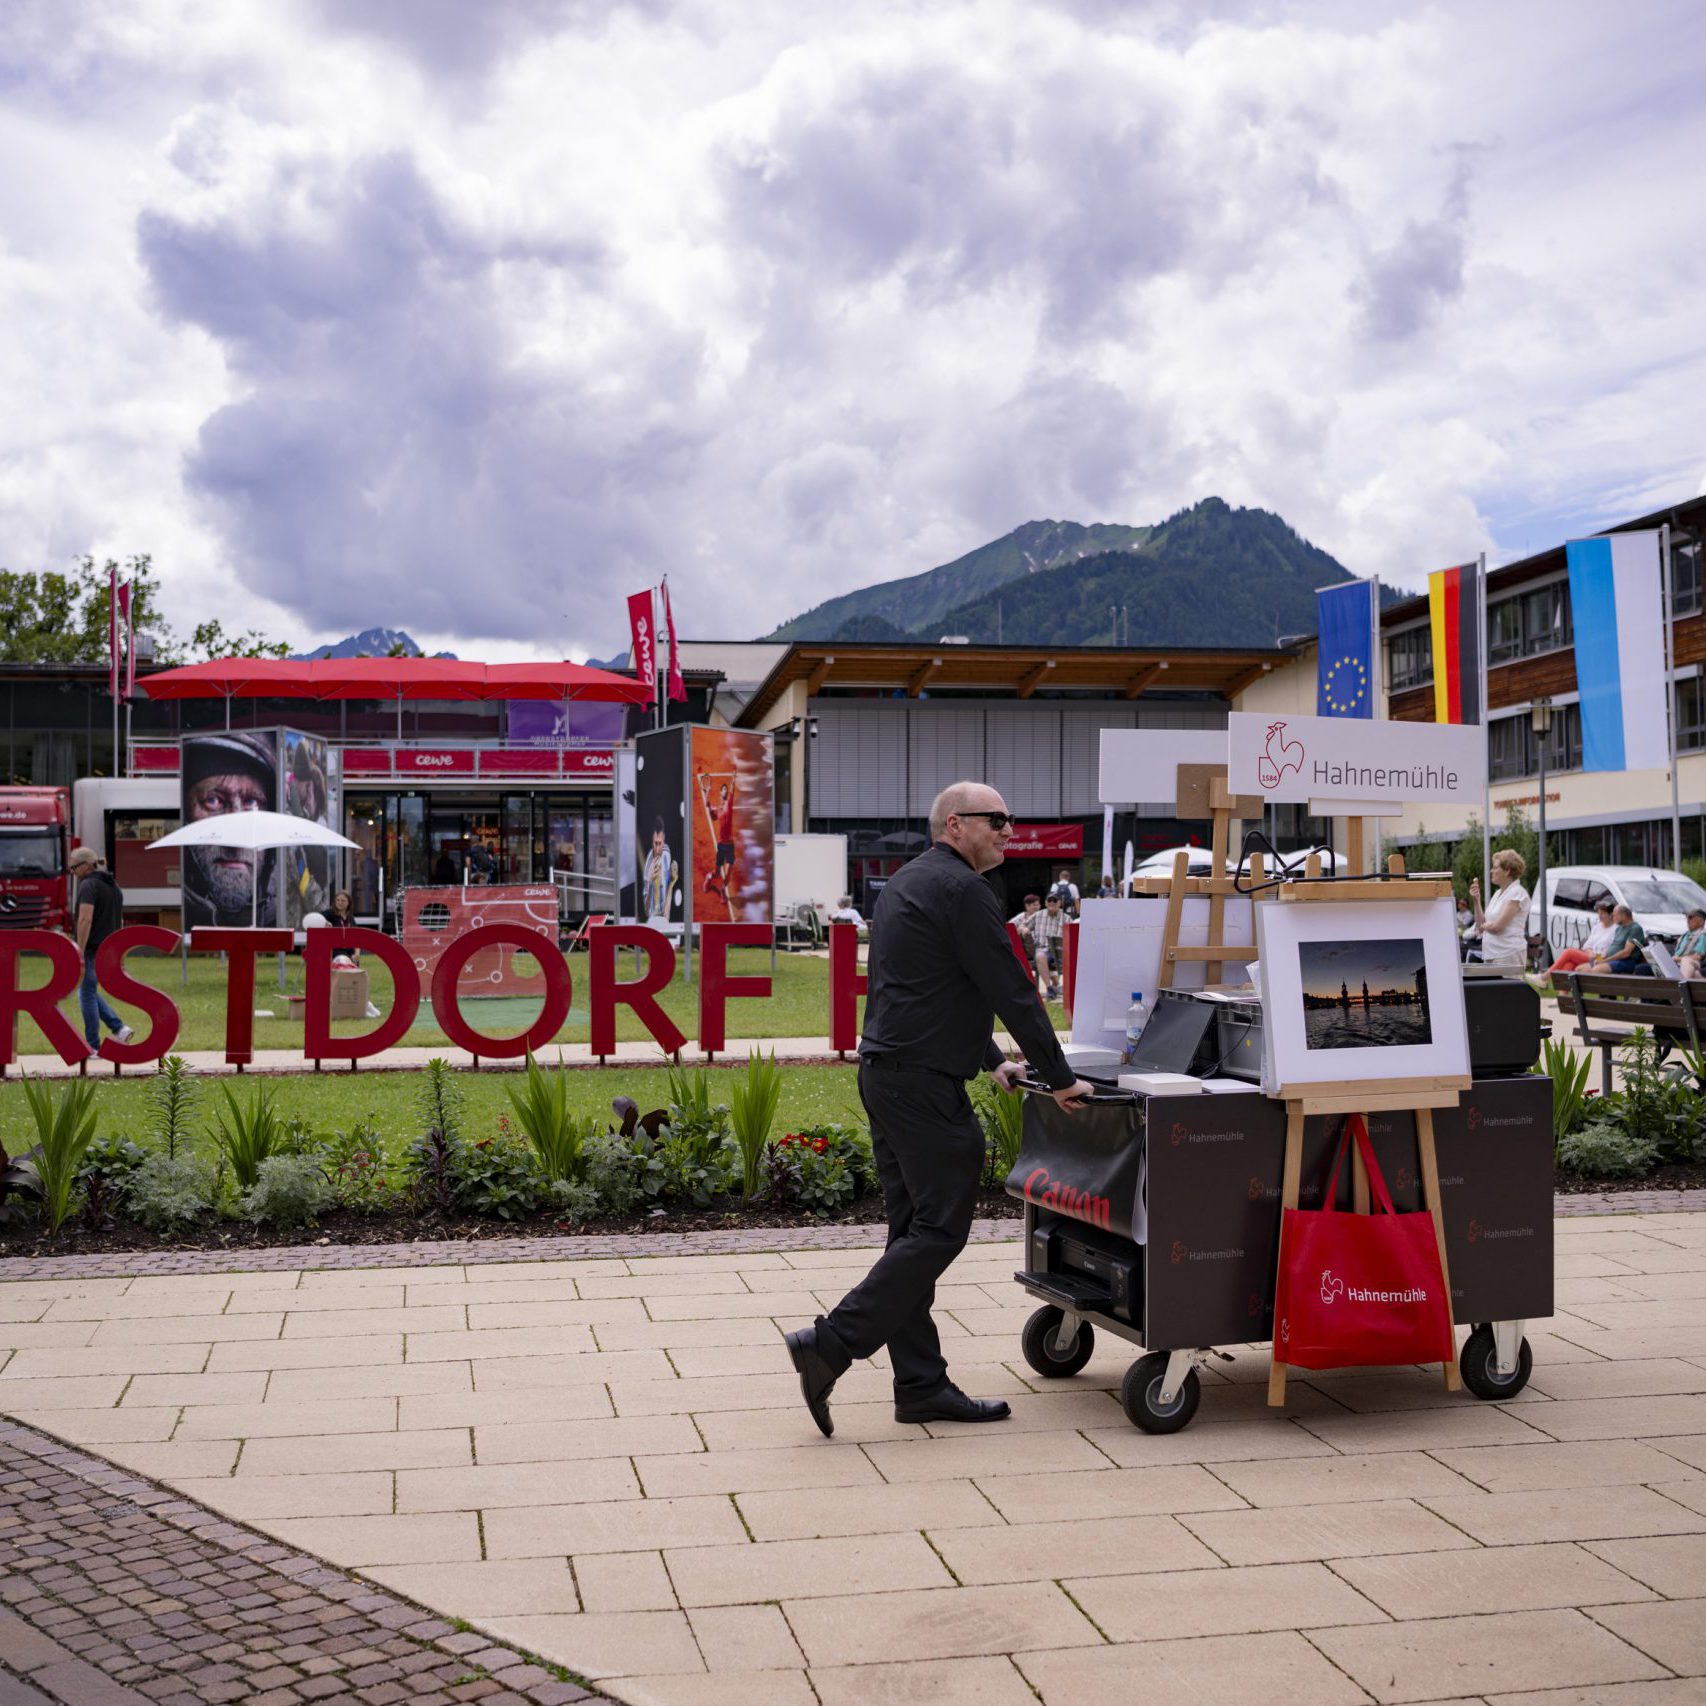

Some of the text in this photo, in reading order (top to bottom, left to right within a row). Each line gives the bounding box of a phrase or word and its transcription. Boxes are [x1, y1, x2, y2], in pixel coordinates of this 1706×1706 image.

[637, 616, 654, 686] cewe
[415, 754, 454, 766] cewe
[583, 755, 614, 767] cew
[1262, 774, 1278, 783] 1584
[1313, 760, 1459, 790] Hahnemühle
[524, 888, 552, 897] cewe
[1483, 1115, 1534, 1127] Hahnemühle
[1189, 1131, 1245, 1144] Hahnemühle
[1023, 1167, 1111, 1232] Canon
[1484, 1226, 1534, 1239] Hahnemühle
[1189, 1248, 1245, 1261] Hahnemühle
[1347, 1287, 1427, 1303] Hahnemühle
